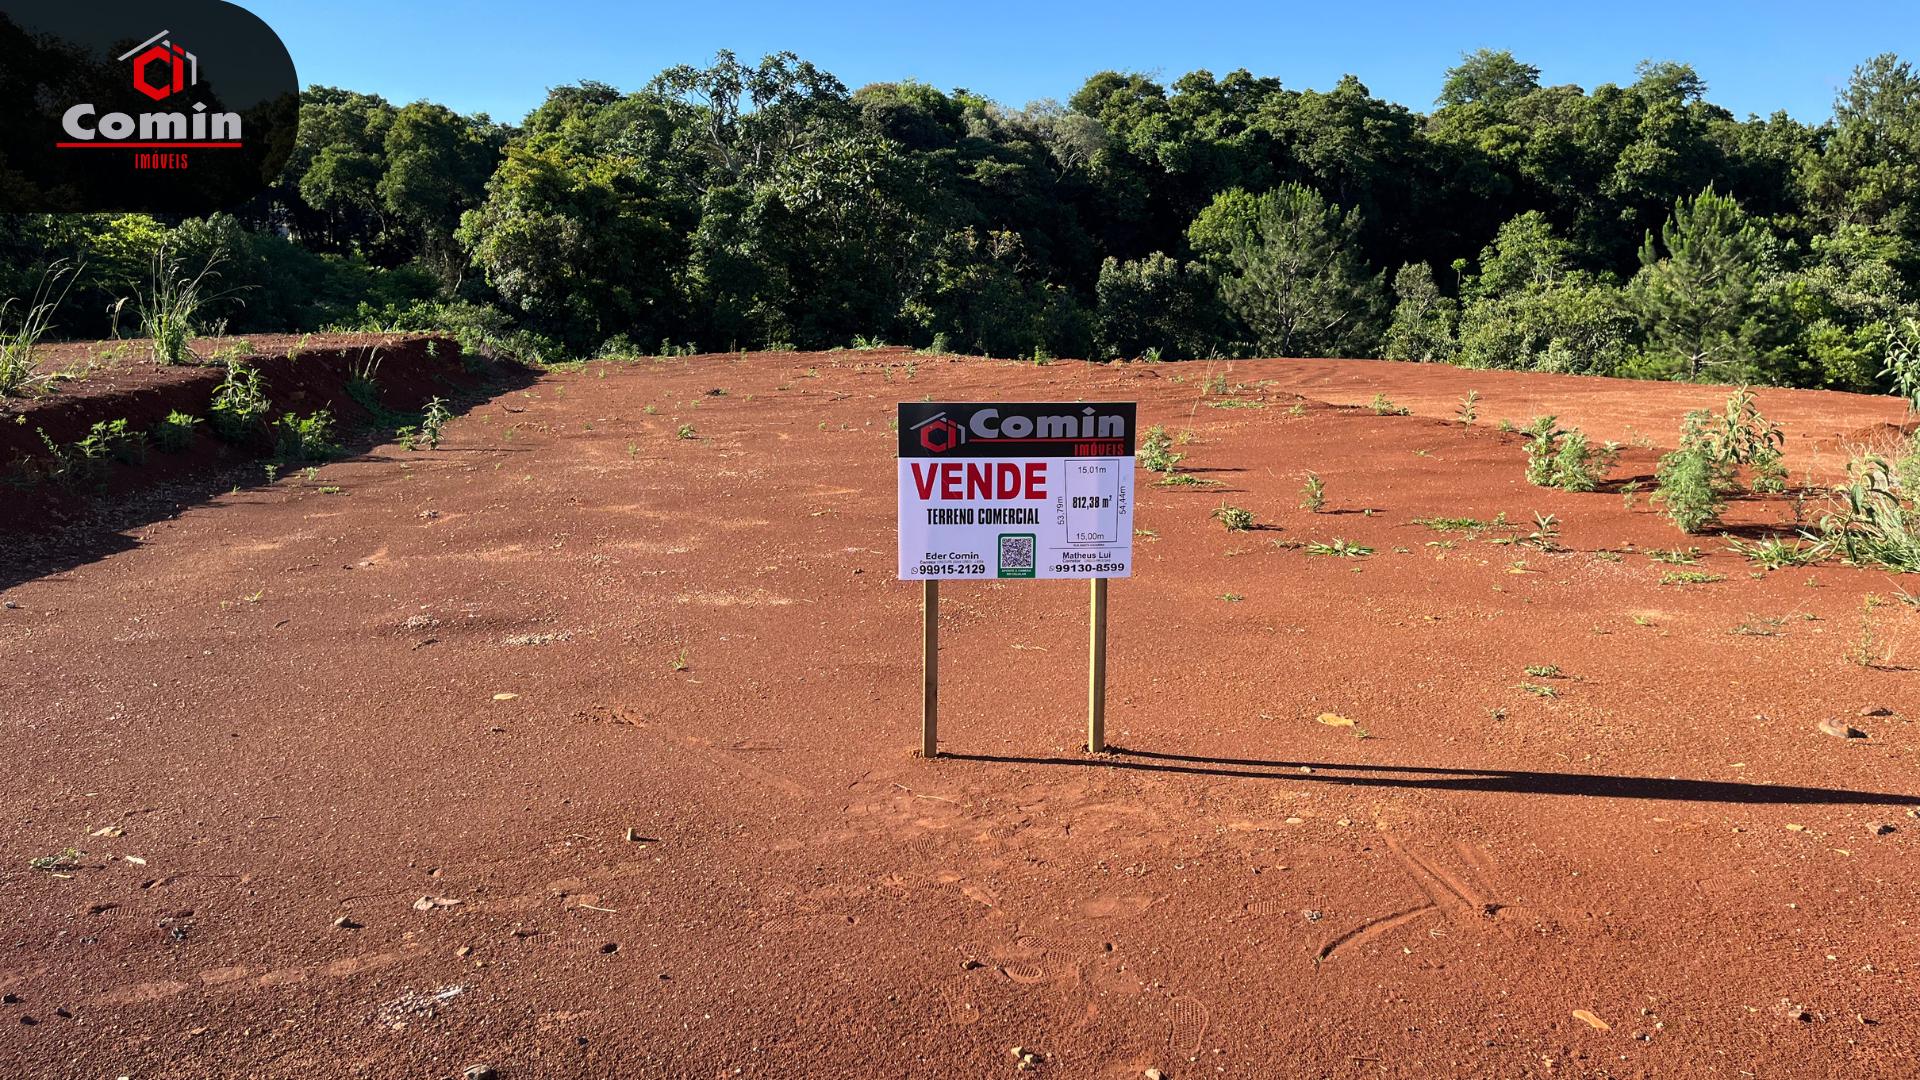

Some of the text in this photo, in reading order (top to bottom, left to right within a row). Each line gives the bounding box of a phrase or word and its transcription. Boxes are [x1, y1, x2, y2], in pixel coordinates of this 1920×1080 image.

[969, 406, 1125, 439] Comin
[1074, 441, 1124, 456] IMÓVEIS
[911, 462, 1047, 500] VENDE
[1072, 496, 1099, 510] 812,38
[927, 508, 1039, 525] TERRENO COMERCIAL
[925, 552, 979, 560] Eder Comin
[1062, 551, 1111, 559] Matheus Lui
[919, 564, 985, 575] 99915-2129
[1055, 563, 1125, 573] 99130-8599
